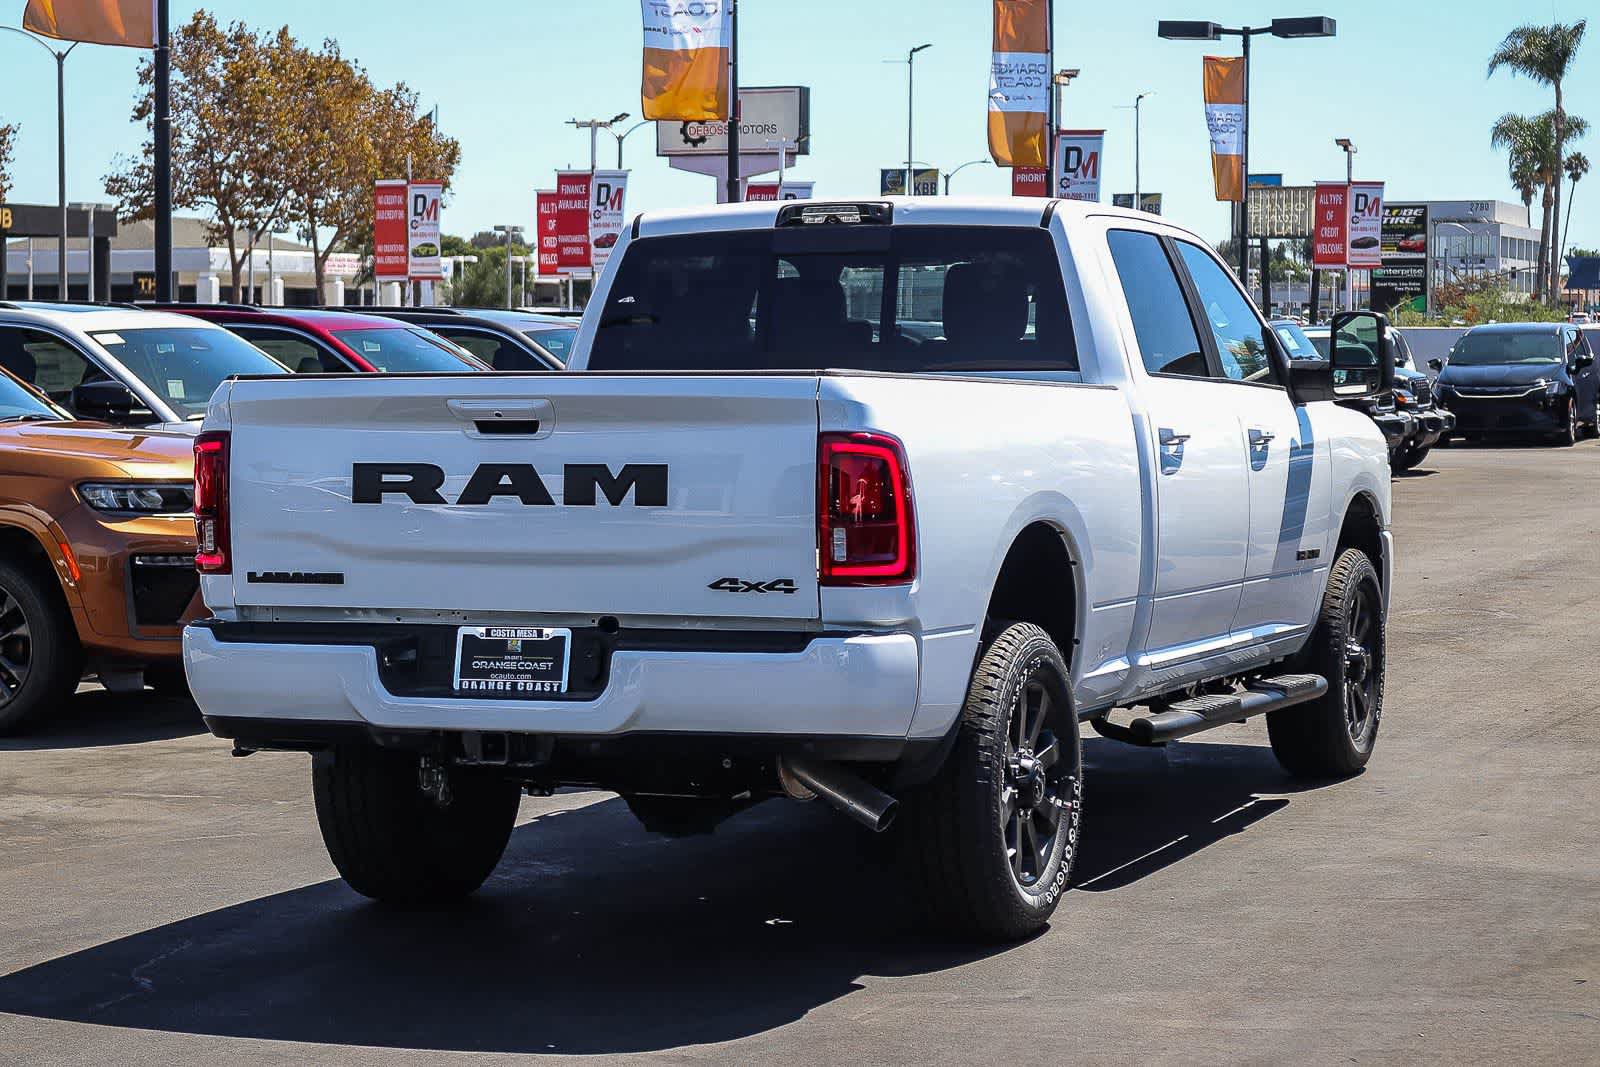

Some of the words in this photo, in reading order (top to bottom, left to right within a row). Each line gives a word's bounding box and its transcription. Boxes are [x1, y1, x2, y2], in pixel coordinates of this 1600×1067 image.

[688, 125, 729, 135] DEBOSS
[1016, 173, 1047, 183] PRIORIT
[561, 184, 586, 194] FINANCE
[597, 183, 624, 211] DM
[1319, 194, 1329, 204] ALL
[1330, 194, 1344, 205] TYPE
[413, 194, 439, 221] DM
[540, 203, 550, 214] ALL
[558, 199, 588, 209] AVAILABLE
[1355, 193, 1381, 217] DM
[1326, 211, 1335, 221] OF
[1320, 226, 1340, 238] CREDIT
[543, 236, 558, 248] CRED
[1316, 243, 1344, 255] WELCOME
[541, 253, 558, 265] WELCO
[1377, 267, 1423, 277] enterprise
[352, 462, 669, 507] RAM
[490, 629, 516, 638] COSTA
[516, 629, 538, 638] MESA
[490, 673, 532, 681] ocauto.com
[462, 680, 512, 691] ORANGE
[517, 682, 560, 692] COAST
